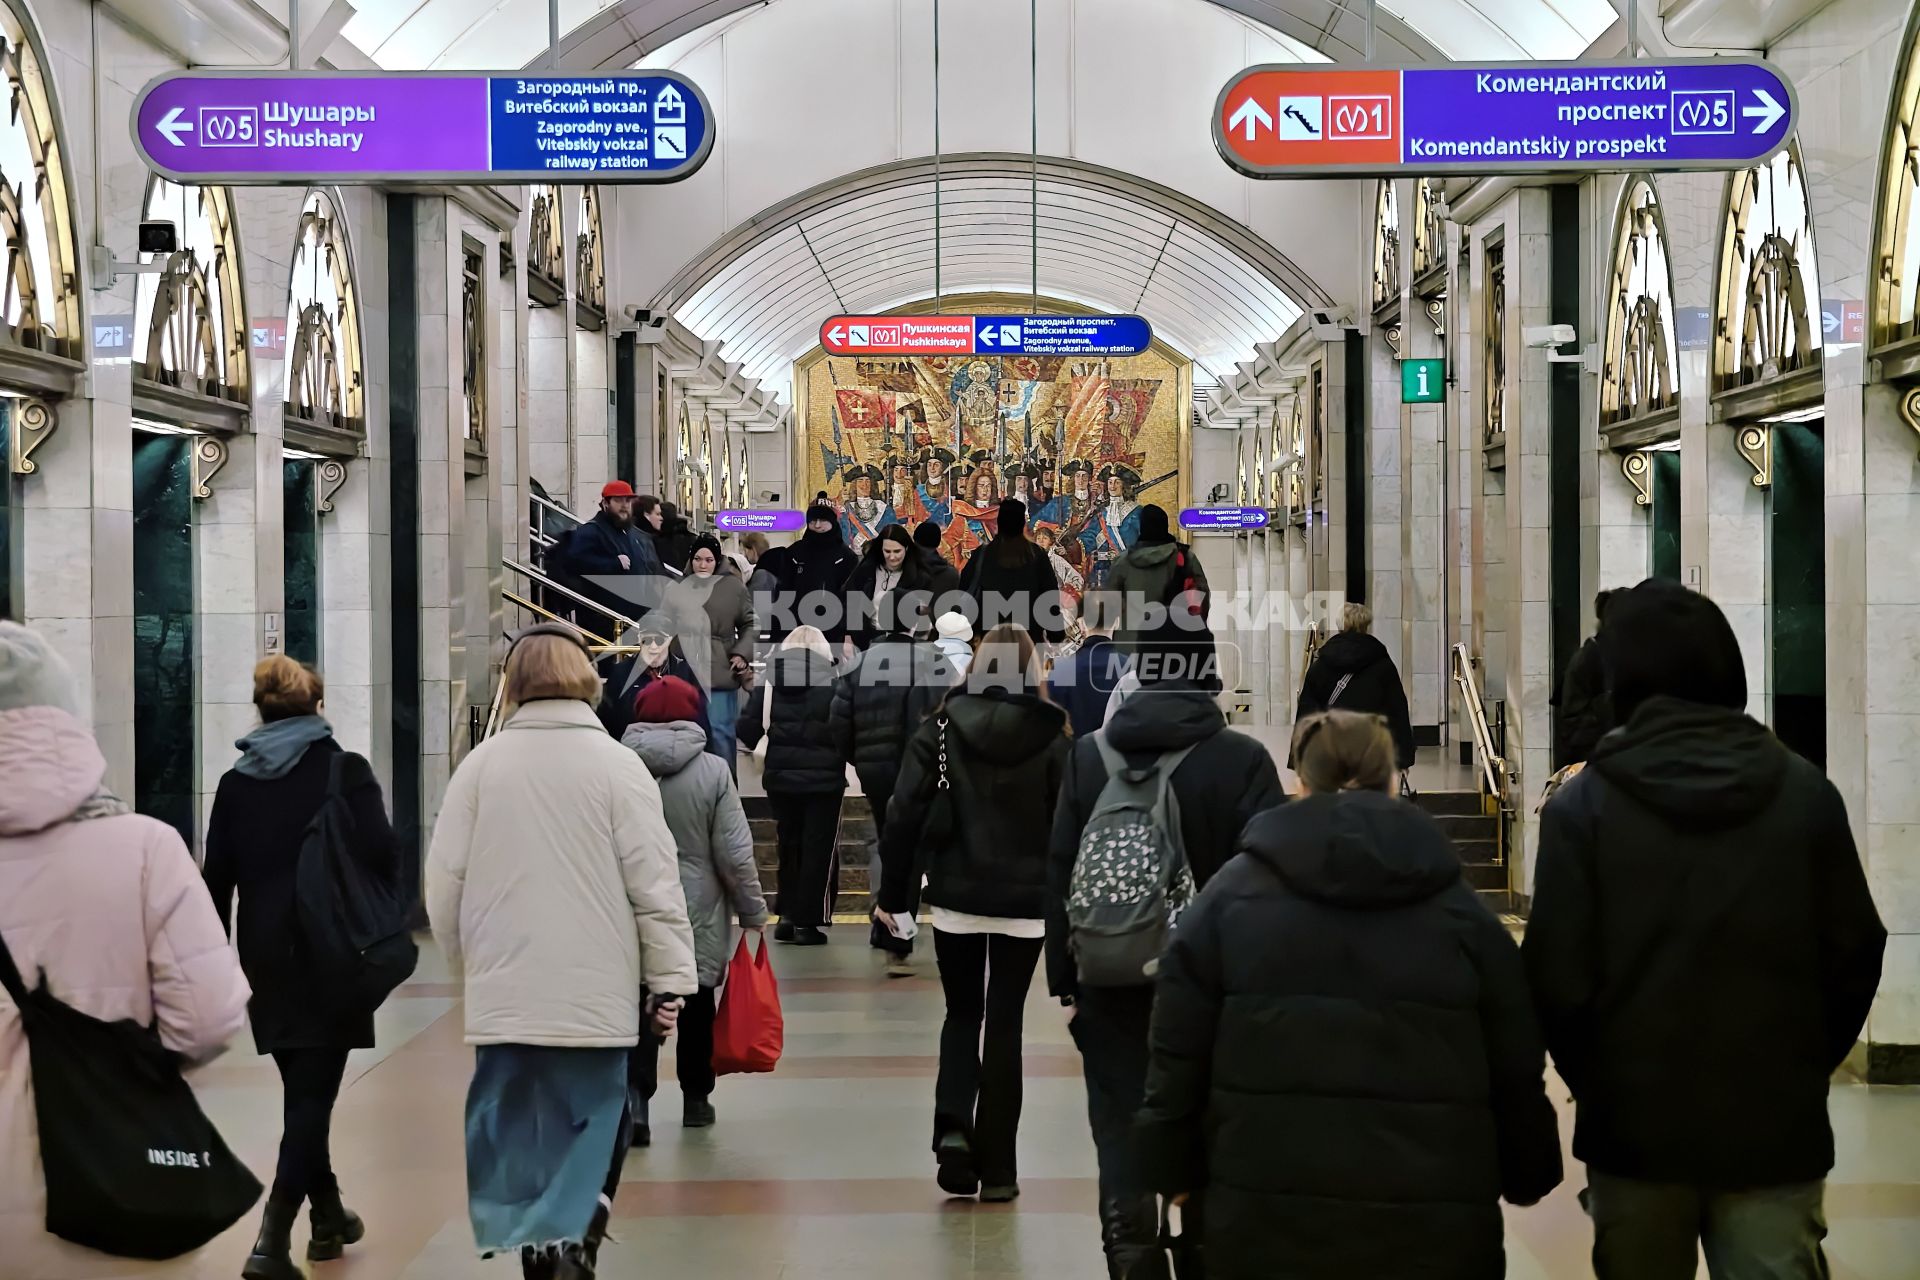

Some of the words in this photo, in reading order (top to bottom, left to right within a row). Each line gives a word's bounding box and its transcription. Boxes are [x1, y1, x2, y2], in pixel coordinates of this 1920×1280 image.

[517, 80, 615, 97] Загородный
[619, 82, 648, 97] пр.,
[1476, 70, 1667, 95] Комендантский
[264, 101, 376, 128] Шушары
[506, 99, 590, 114] Витебский
[593, 101, 648, 114] вокзал
[1558, 103, 1667, 125] проспект
[537, 120, 612, 137] Zagorodny
[615, 122, 648, 134] ave.,
[264, 128, 364, 152] Shushary
[537, 137, 601, 154] Vitebskiy
[603, 138, 648, 151] vokzal
[1411, 136, 1570, 156] Komendantskiy
[1575, 135, 1667, 158] prospekt
[546, 155, 598, 171] railway
[600, 156, 648, 168] station
[902, 323, 970, 335] Пушкинская
[1023, 317, 1076, 327] Загородный
[1076, 318, 1116, 327] проспект,
[1023, 326, 1067, 335] Витебский
[1069, 327, 1098, 335] вокзал
[902, 337, 967, 348] Pushkinskaya
[1023, 337, 1062, 346] Zagorodny
[1063, 338, 1092, 346] avenue,
[1023, 345, 1057, 354] Vitebskiy
[1057, 345, 1081, 353] vokzal
[1081, 345, 1108, 354] railway
[1109, 345, 1135, 353] station
[147, 1148, 200, 1168] INSIDE
